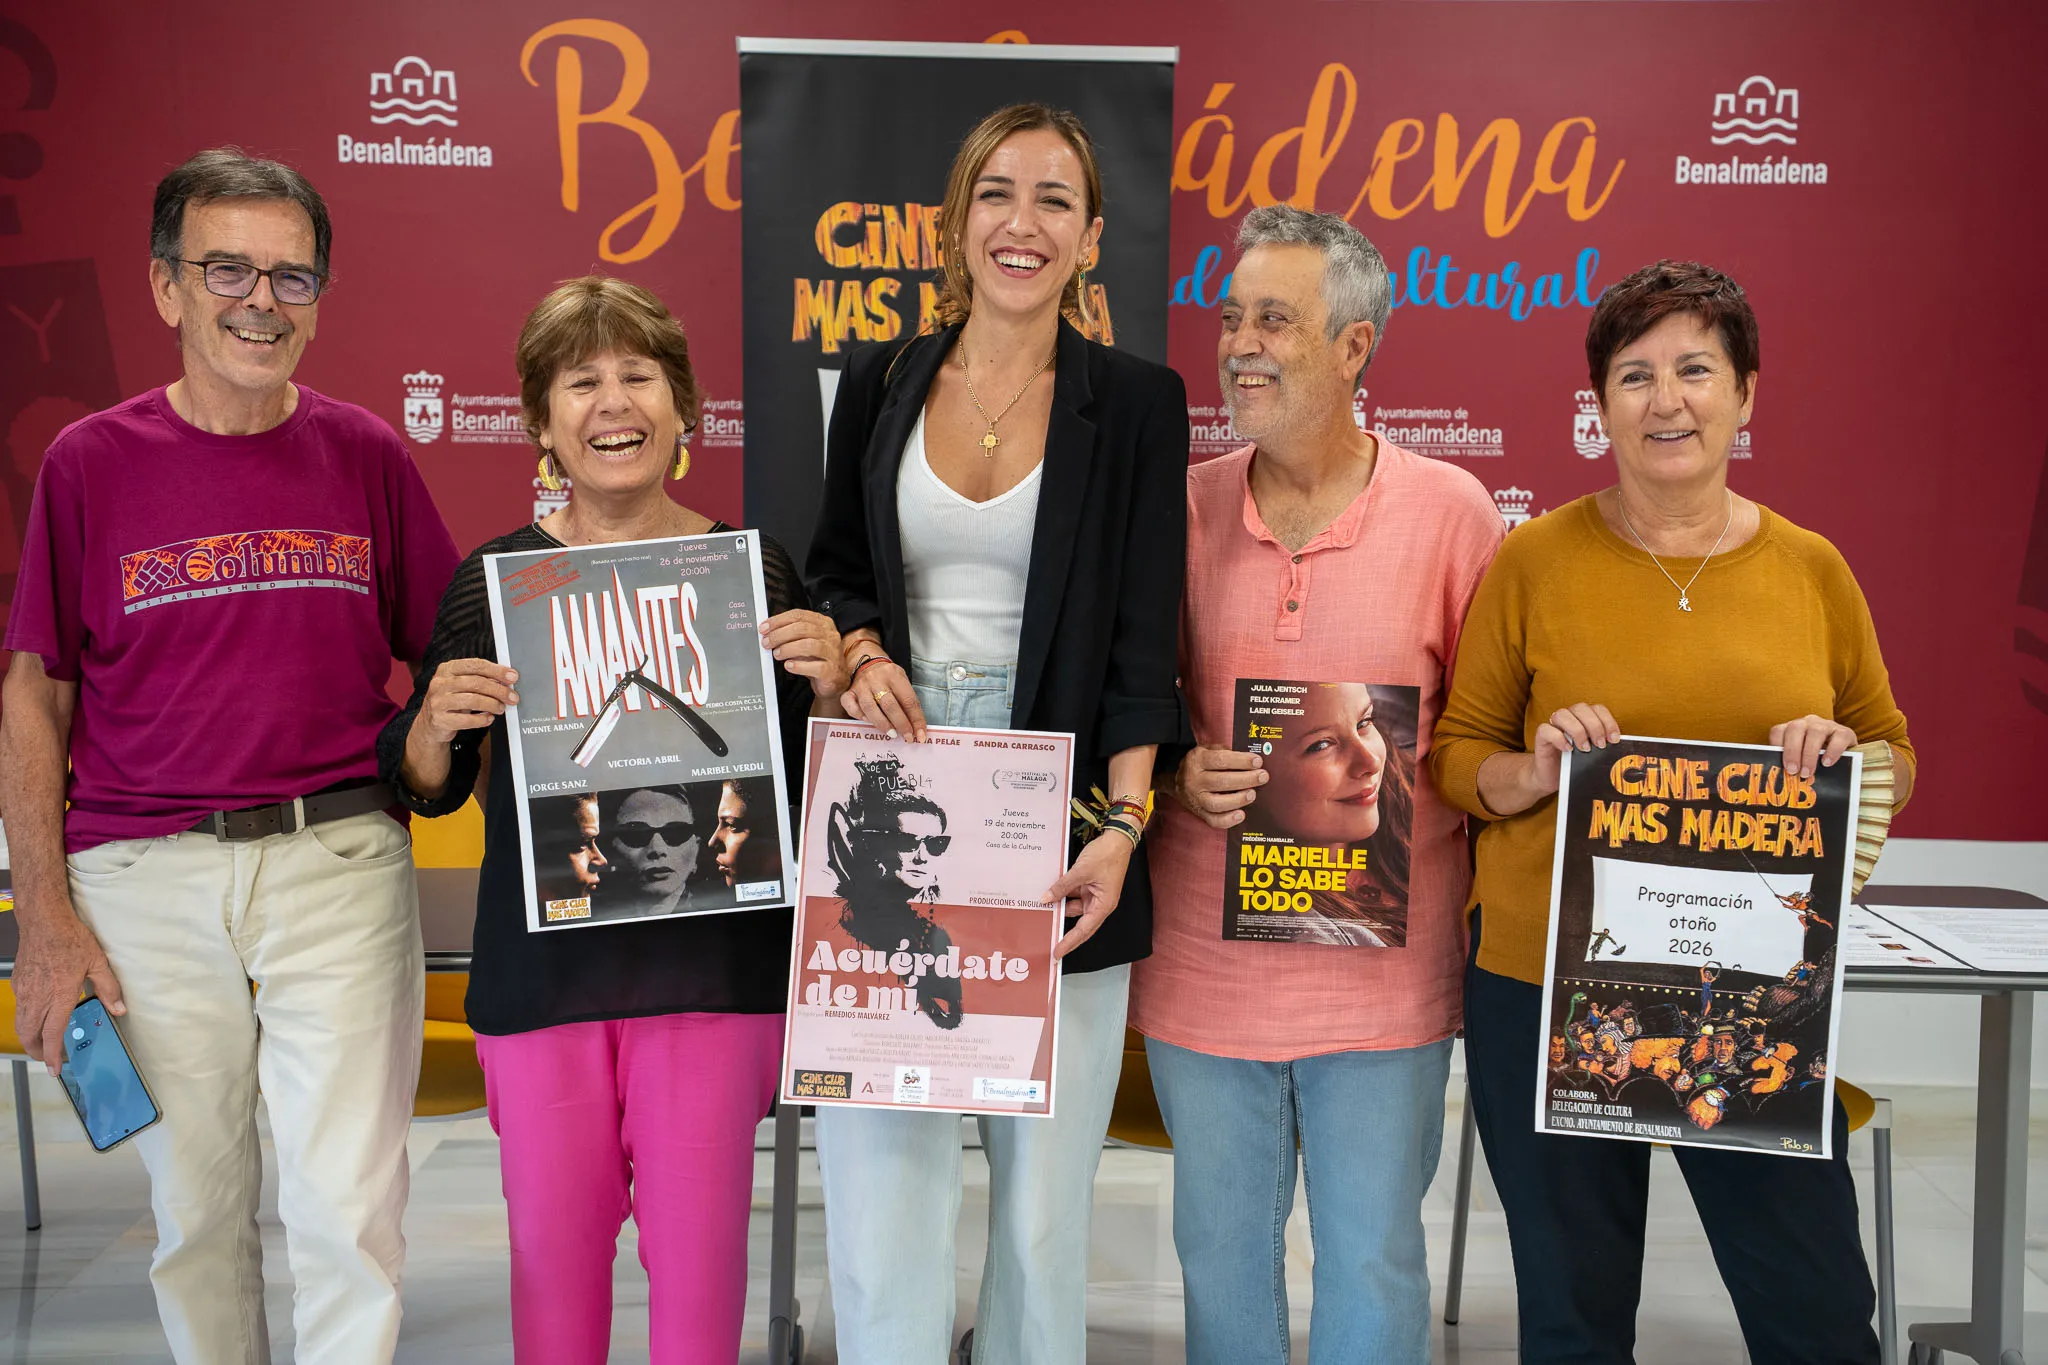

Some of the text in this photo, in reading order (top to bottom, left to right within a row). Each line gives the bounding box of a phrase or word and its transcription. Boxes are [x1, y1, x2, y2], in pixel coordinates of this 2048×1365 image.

[337, 134, 493, 168] Benalmádena
[1675, 155, 1828, 184] Benalmádena
[792, 277, 902, 353] MAS
[1374, 406, 1468, 420] Ayuntamiento de
[1374, 421, 1503, 444] Benalmádena
[678, 543, 707, 552] Jueves
[174, 540, 362, 587] Columbia
[660, 553, 728, 566] 26 de noviembre
[680, 566, 710, 576] 20:00h
[134, 582, 276, 610] ESTABLISHED
[296, 579, 314, 587] IN
[728, 601, 746, 609] Casa
[729, 610, 747, 619] de la
[726, 621, 752, 630] Cultura
[550, 564, 710, 720] AMANTES
[1274, 685, 1307, 693] JENTSCH
[522, 721, 585, 735] VICENTE ARANDA
[830, 731, 861, 739] ADELFA
[974, 740, 1008, 749] SANDRA
[1011, 742, 1055, 751] CARRASCO
[608, 754, 681, 769] VICTORIA ABRIL
[855, 751, 866, 760] LA
[691, 765, 730, 777] MARIBEL
[870, 765, 880, 773] DE
[529, 779, 588, 794] JORGE SANZ
[1716, 762, 1817, 810] CLUB
[1002, 808, 1029, 817] Jueves
[995, 819, 1004, 827] de
[1006, 821, 1046, 829] noviembre
[1588, 799, 1824, 859] MAS MADERA
[1000, 831, 1028, 840] 20:00h
[1018, 843, 1042, 851] Cultura
[1241, 845, 1367, 870] MARIELLE
[1240, 867, 1347, 892] LO SABE
[969, 896, 1015, 906] PRODUCCIONES
[1239, 890, 1313, 913] TODO
[1638, 886, 1753, 910] Programación
[1669, 916, 1717, 932] otoño
[1669, 938, 1713, 957] 2026
[806, 938, 1030, 982] Acuérdate
[805, 974, 920, 1013] de mí
[824, 1010, 856, 1019] REMEDIOS
[857, 1010, 890, 1021] MALVÁREZ
[824, 1074, 846, 1086] CLUB
[796, 1083, 848, 1098] MAS MADERA
[1552, 1088, 1598, 1100] COLABORA:
[1552, 1100, 1632, 1117] DELEGACION DE CULTURA
[1551, 1116, 1682, 1138] EXCMO. AYUNTAMIENTO DE BENALMADENA
